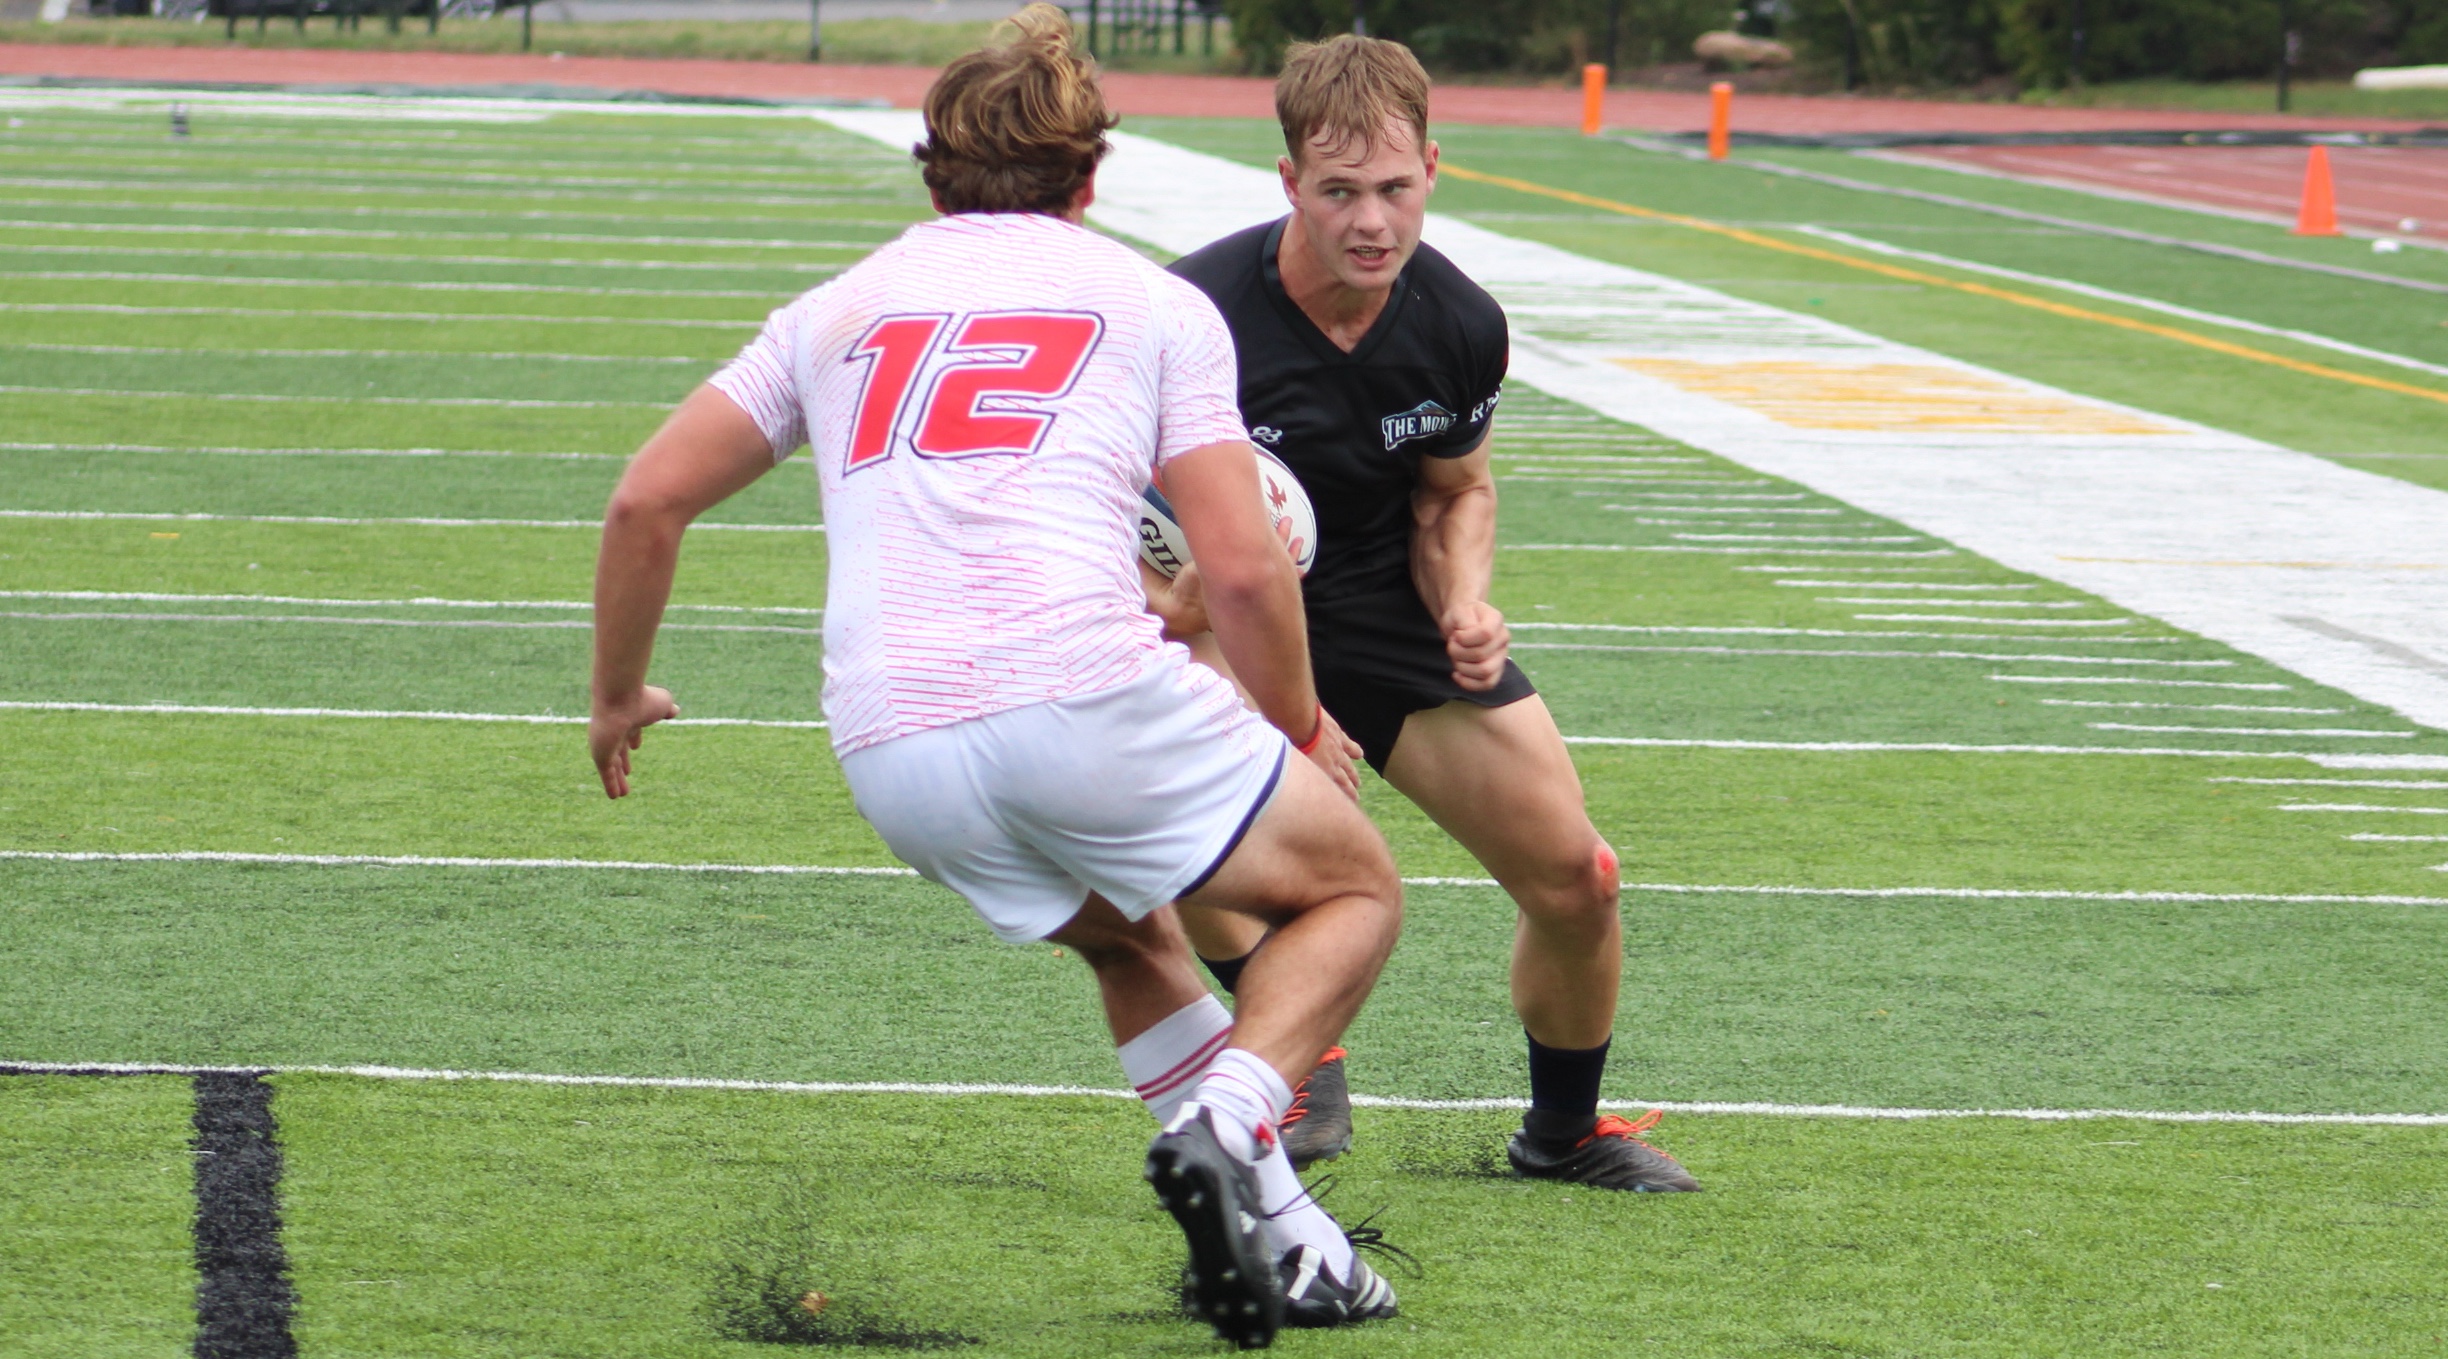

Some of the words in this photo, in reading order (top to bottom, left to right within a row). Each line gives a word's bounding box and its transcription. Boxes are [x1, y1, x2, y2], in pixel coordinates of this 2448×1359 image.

[843, 308, 1105, 478] 12
[1385, 416, 1417, 444] THE
[1138, 516, 1184, 578] GIL
